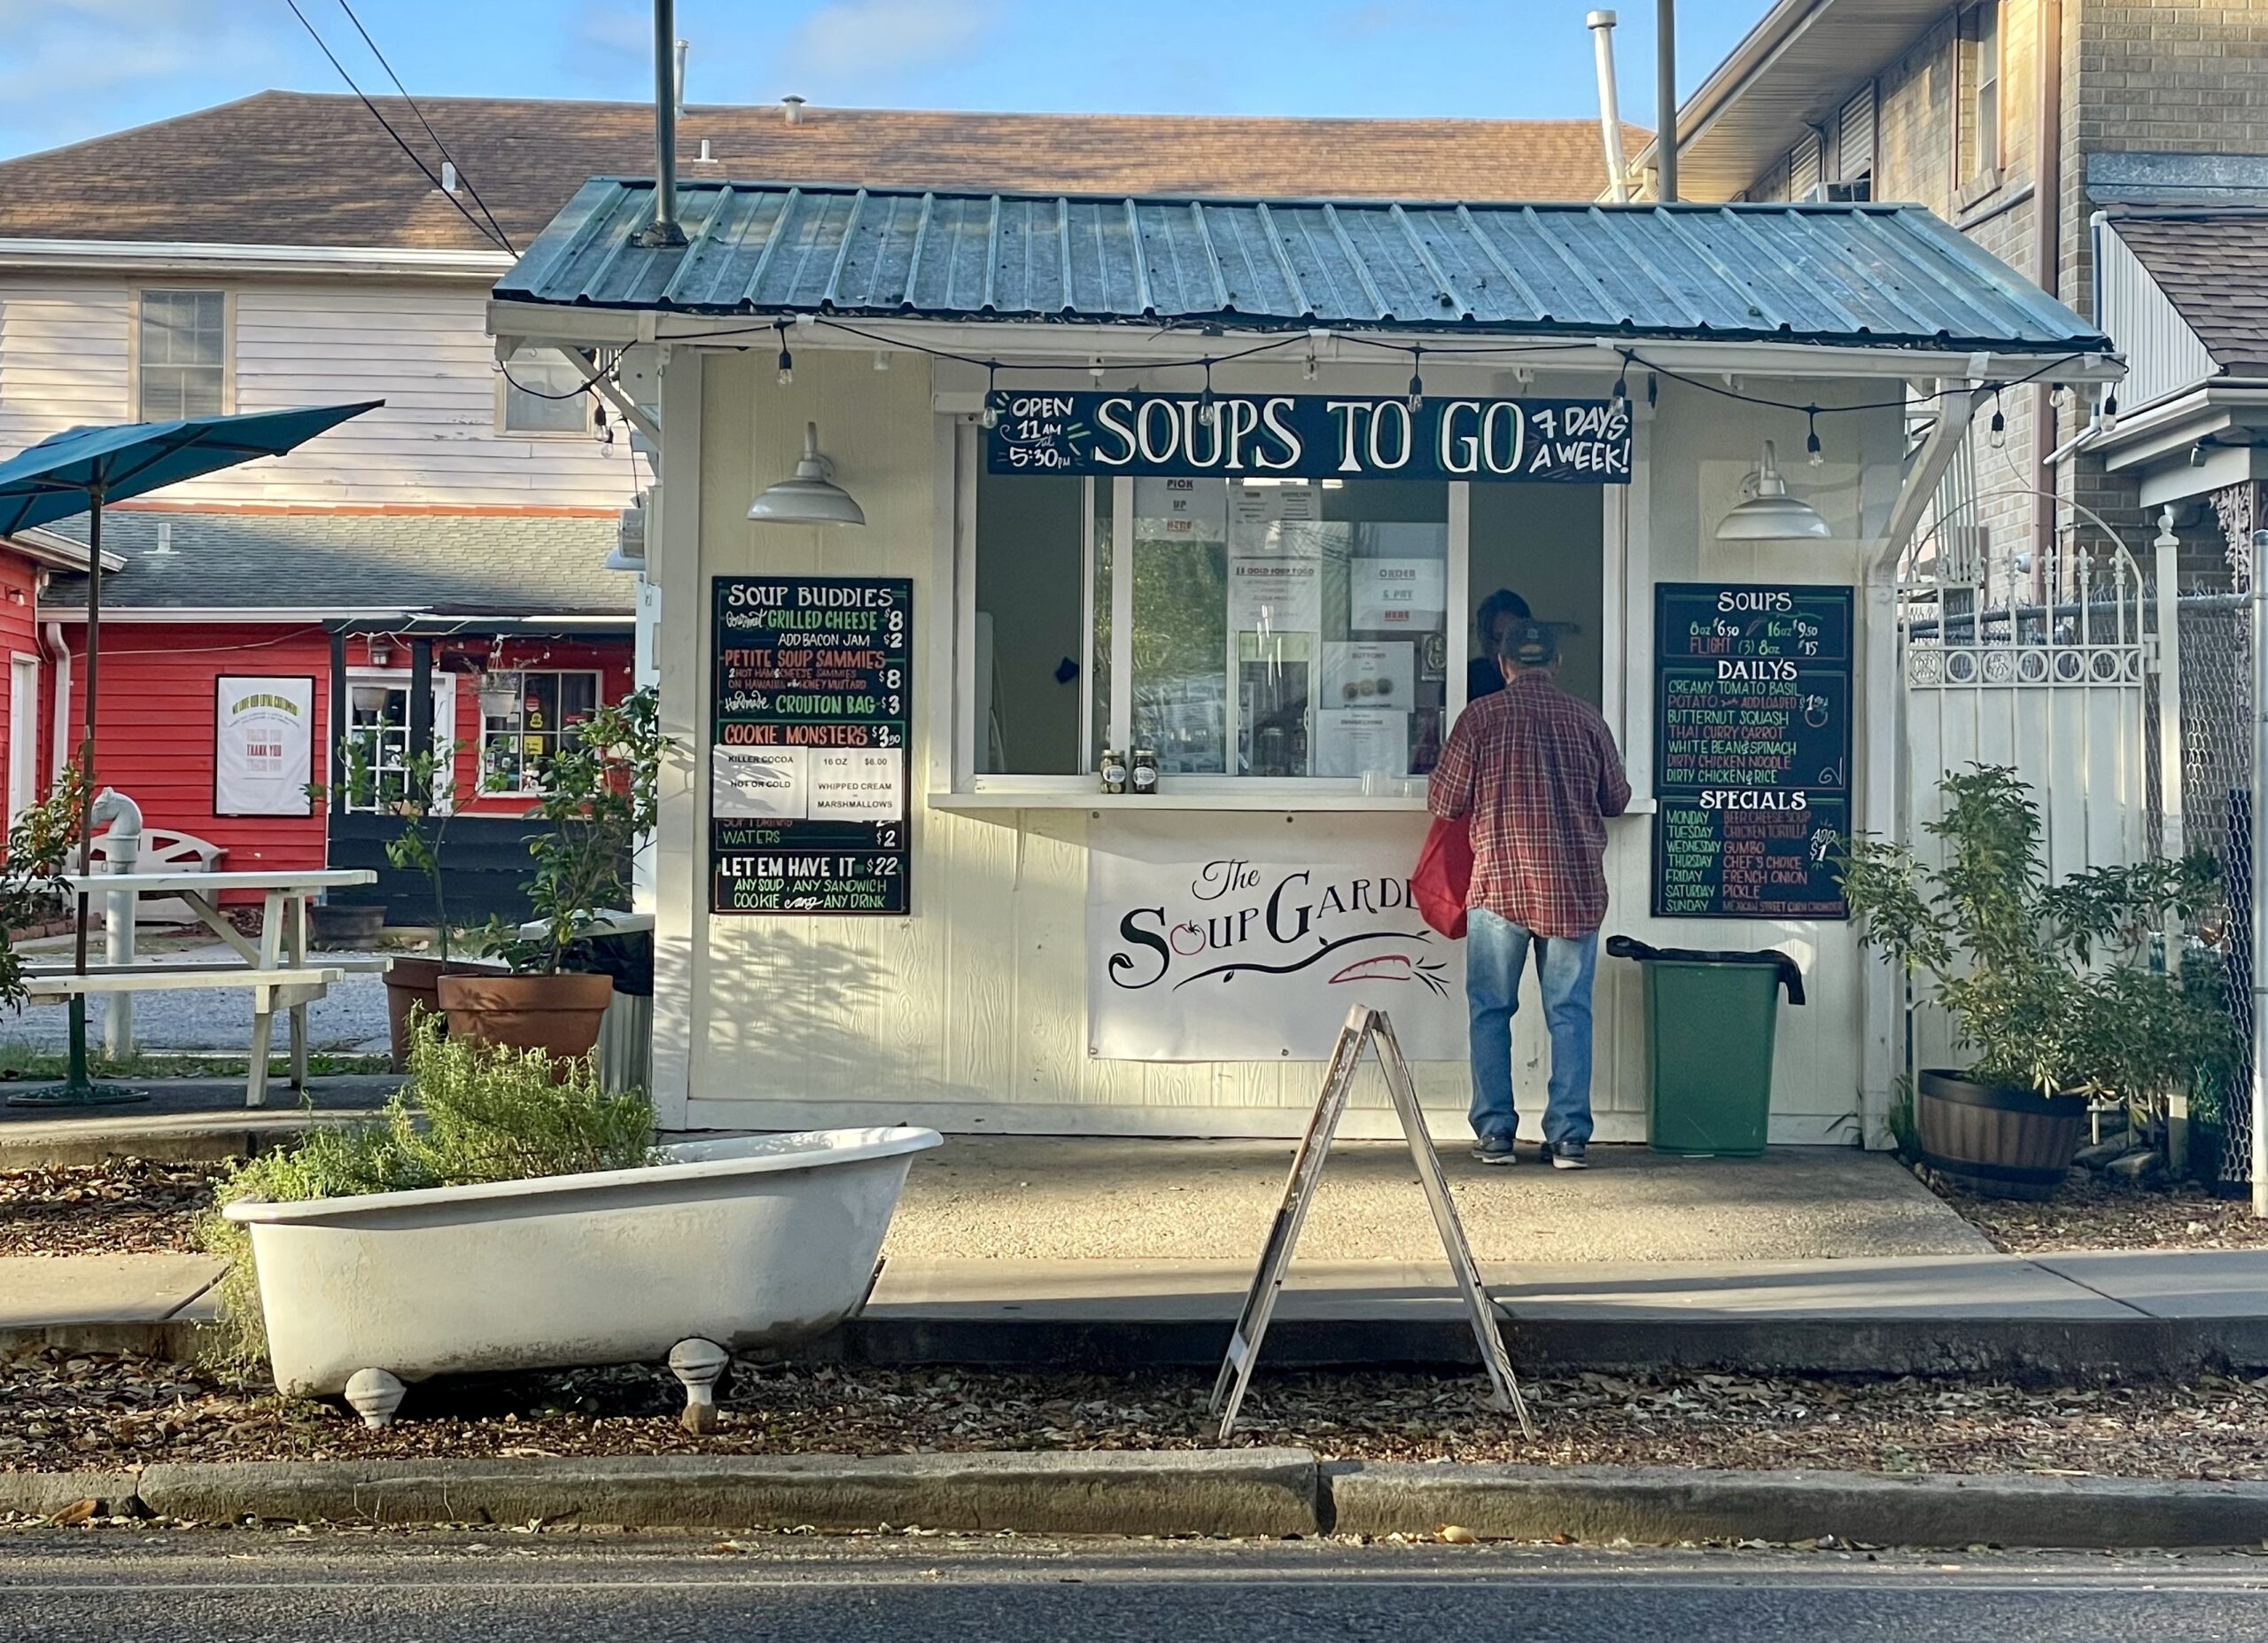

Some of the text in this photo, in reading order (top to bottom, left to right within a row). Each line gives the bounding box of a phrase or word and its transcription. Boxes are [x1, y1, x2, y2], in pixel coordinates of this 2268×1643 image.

[1012, 397, 1074, 418] OPEN
[1531, 406, 1629, 440] 7 DAYS
[1094, 397, 1525, 473] SOUPS TO GO
[1528, 438, 1630, 474] A WEEK!
[1167, 479, 1193, 490] PICK
[1173, 500, 1187, 510] UP
[1379, 569, 1416, 580] ORDER
[728, 584, 893, 607] SOUP BUDDIES
[1717, 591, 1792, 612] SOUPS
[767, 609, 822, 630] GRILLED
[825, 610, 877, 631] CHEESE
[778, 633, 800, 647] ADD
[802, 633, 840, 647] BACON
[843, 633, 870, 648] JAM
[1689, 636, 1732, 654] FLIGHT
[725, 649, 886, 670] PETITE SOUP SAMMIES
[728, 667, 736, 679] 2
[1717, 658, 1798, 681] DAILYS
[728, 680, 742, 689] ON
[1668, 680, 1802, 697] CREAMY TOMATO BASIL
[775, 694, 842, 715] CROUTON
[846, 695, 876, 714] BAG
[1667, 695, 1719, 708] POTATO
[1740, 697, 1760, 709] ADD
[1667, 710, 1789, 726] BUTTERNUT SQUASH
[725, 724, 778, 744] COOKIE
[785, 725, 868, 745] MONSTERS
[1668, 725, 1787, 739] THAI CURRY CARROT
[247, 744, 282, 757] THANK YOU
[1668, 740, 1708, 754] WHITE
[1750, 741, 1797, 755] SPINACH
[728, 755, 794, 764] KILLER COCOA
[1667, 754, 1791, 769] DIRTY CHICKEN NOODLE
[1666, 768, 1694, 783] DIRTY
[1697, 768, 1746, 783] CHICKEN
[1754, 769, 1778, 783] RICE
[765, 780, 791, 789] COLD
[1699, 790, 1807, 811] SPECIALS
[1666, 810, 1710, 825] MONDAY
[722, 829, 781, 845] WATERS
[1666, 825, 1714, 839] TUESDAY
[1722, 825, 1766, 838] CHICKEN
[1666, 839, 1765, 854] WEDNESDAY GUMBO
[721, 856, 898, 877] LET EM HAVE IT $22
[1666, 853, 1713, 868] THURSDAY
[1766, 856, 1802, 869] CHOICE
[1192, 859, 1261, 901] The
[1666, 868, 1807, 884] FRIDAY FRENCH ONION
[734, 877, 757, 892] ANY
[792, 878, 822, 893] ANY
[822, 878, 888, 893] SANDWICH
[1665, 884, 1761, 899] SATURDAY PICKLE
[734, 892, 781, 909] COOKIE
[822, 893, 849, 909] ANY
[850, 892, 887, 909] DRINK
[1666, 899, 1709, 912] SUNDAY
